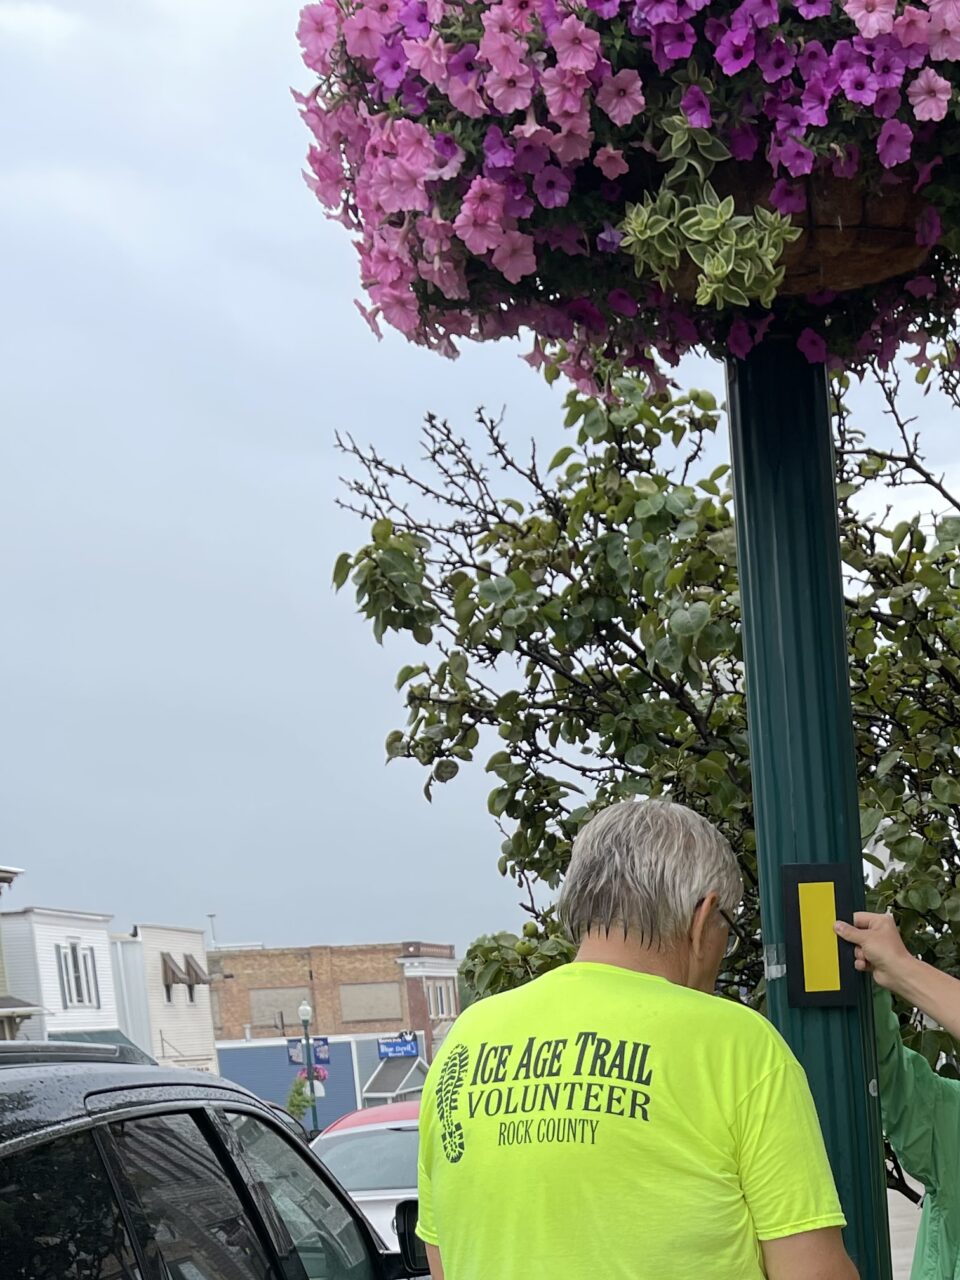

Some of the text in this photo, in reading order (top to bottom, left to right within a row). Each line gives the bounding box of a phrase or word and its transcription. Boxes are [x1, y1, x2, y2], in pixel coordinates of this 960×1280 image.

[469, 1032, 653, 1086] ICE AGE TRAIL
[467, 1082, 651, 1121] VOLUNTEER
[498, 1117, 600, 1146] ROCK COUNTY
